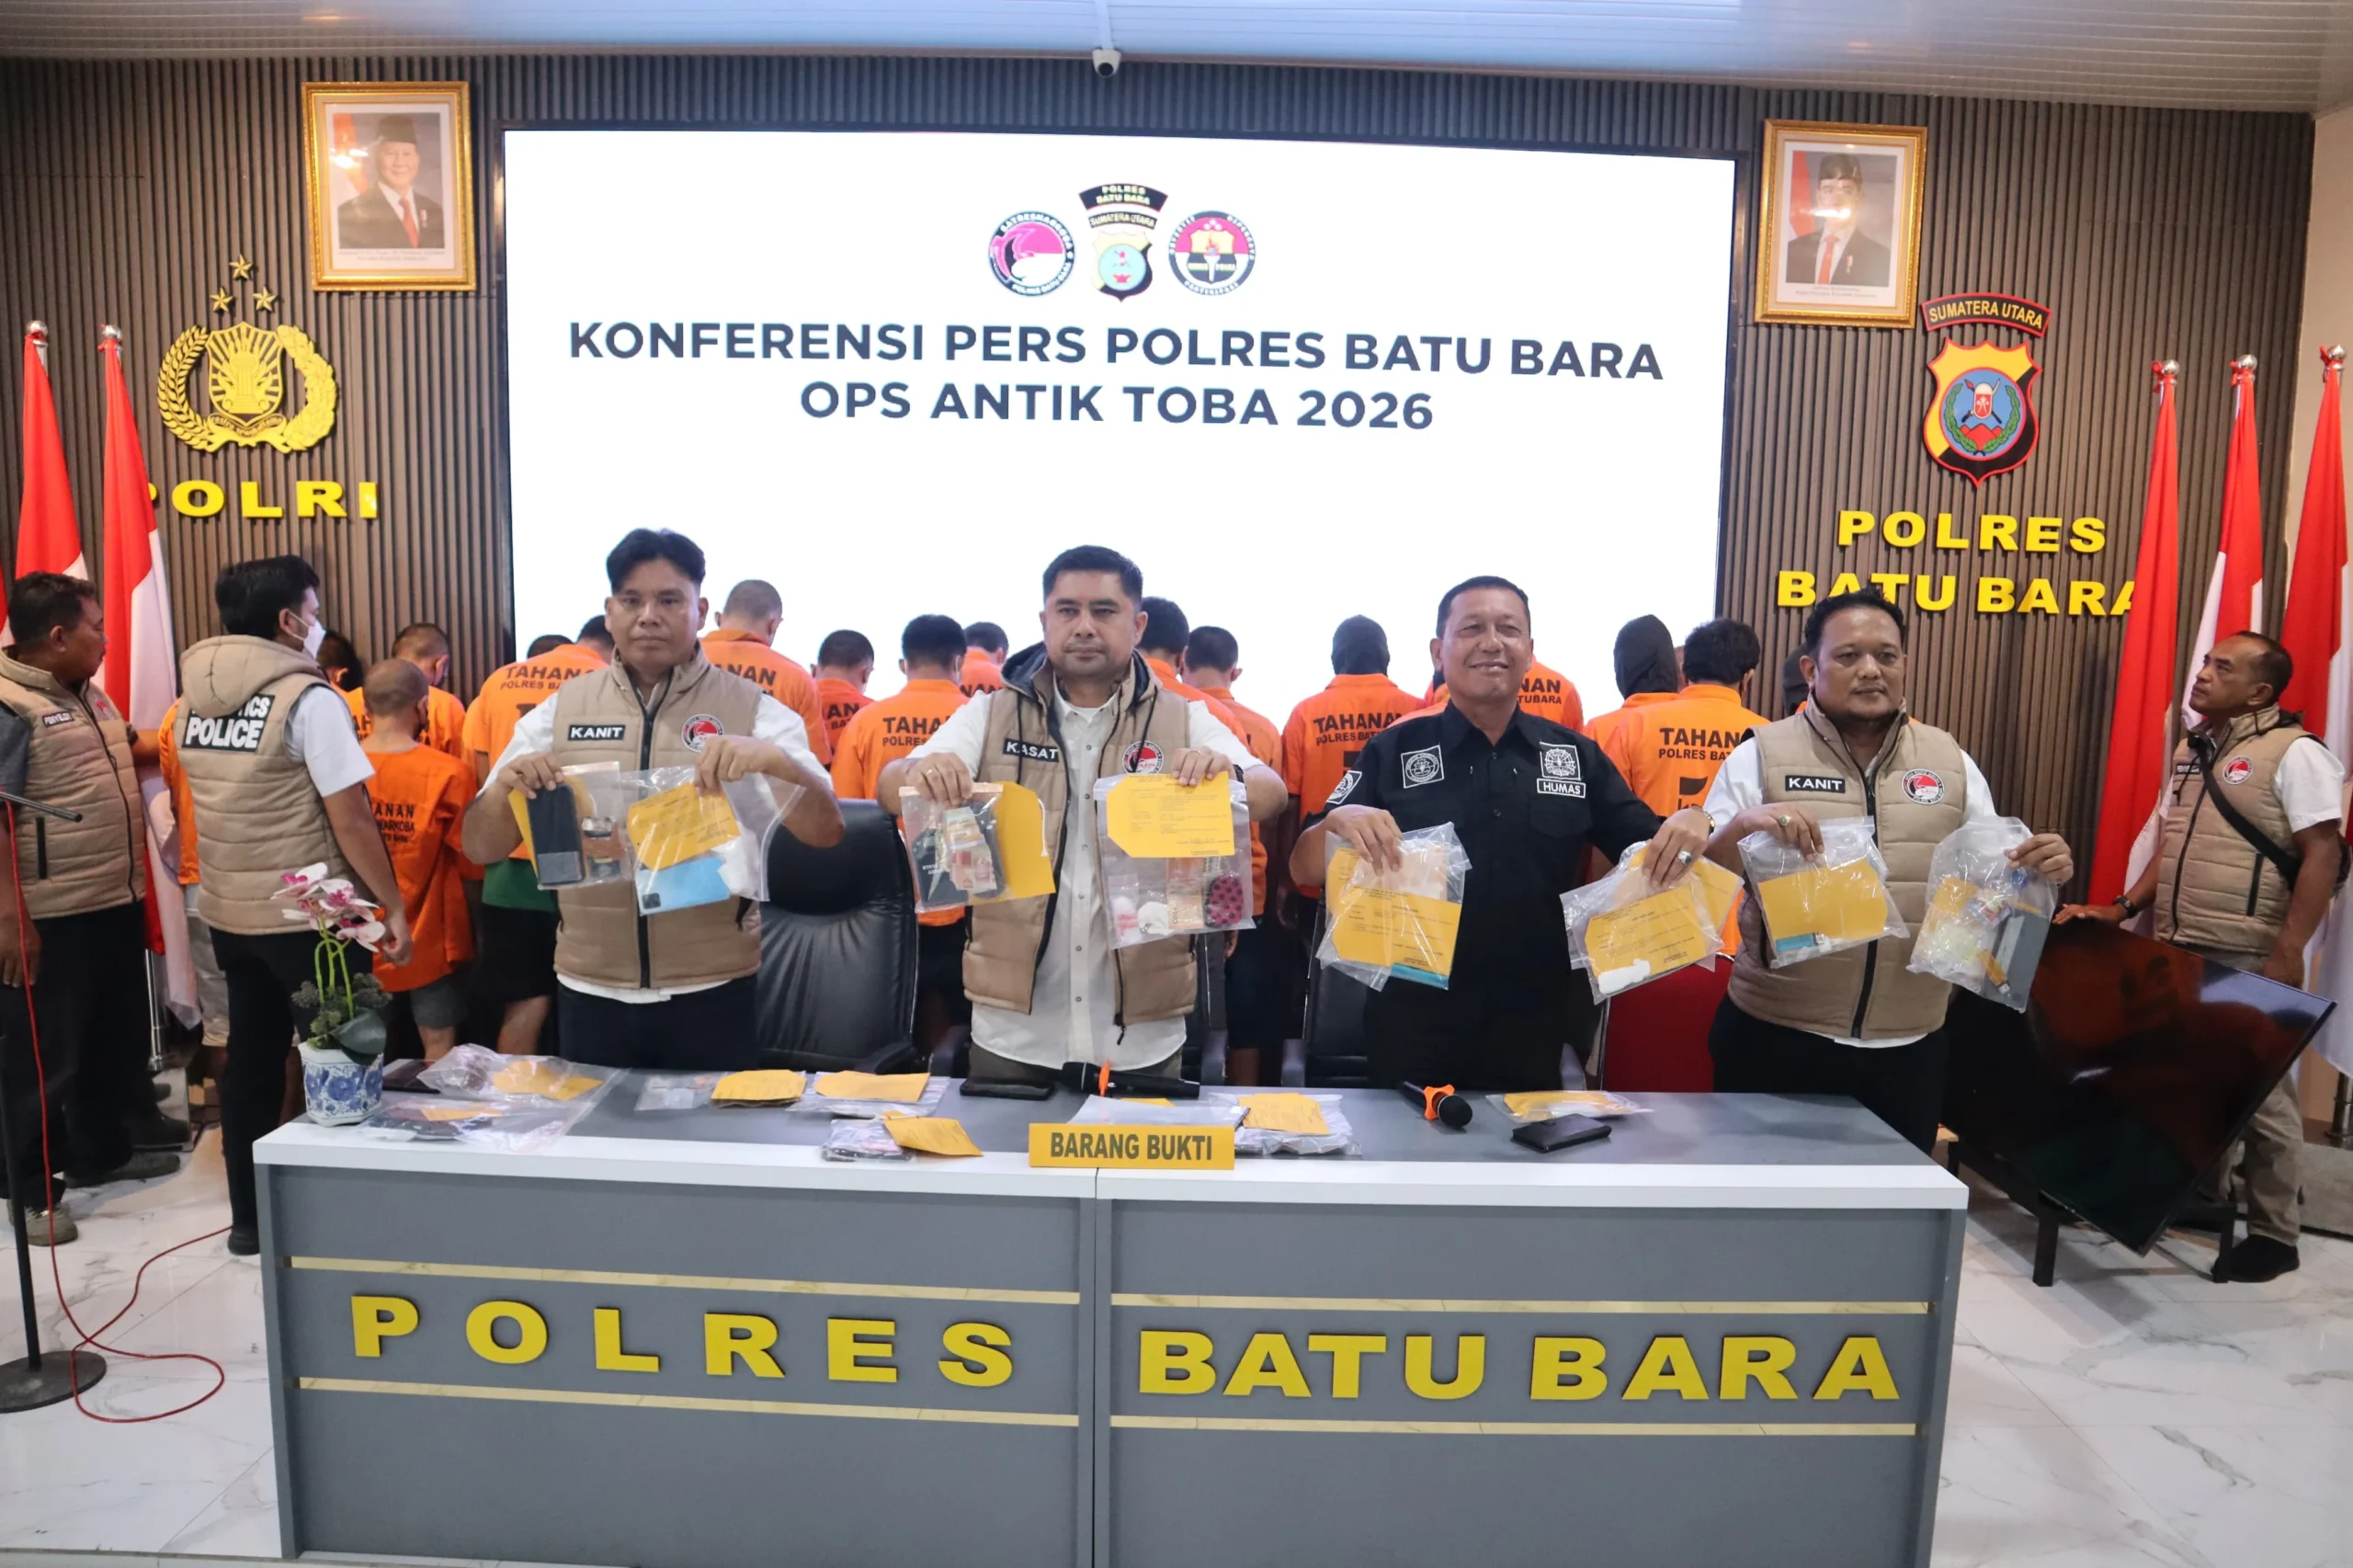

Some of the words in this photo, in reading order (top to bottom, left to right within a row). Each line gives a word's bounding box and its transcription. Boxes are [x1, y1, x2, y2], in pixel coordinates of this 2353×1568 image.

[1928, 301, 1999, 323] SUMATERA
[2002, 302, 2042, 329] UTARA
[570, 322, 923, 361] KONFERENSI
[946, 325, 1086, 363] PERS
[1108, 328, 1326, 369] POLRES
[1346, 334, 1492, 374] BATU
[1511, 339, 1663, 380] BARA
[801, 381, 911, 418] OPS
[931, 383, 1104, 422] ANTIK
[1122, 386, 1279, 426] TOBA
[1297, 391, 1433, 429] 2026
[148, 479, 378, 519] OLRI
[1838, 509, 2106, 553] POLRES
[500, 680, 544, 690] POLRES
[1518, 695, 1562, 704] TUBARA
[185, 716, 265, 749] POLICE
[570, 726, 624, 739] KANIT
[1313, 712, 1402, 733] TAHANA
[1316, 733, 1357, 746] POLRES
[1659, 728, 1741, 748] TAHAN
[1006, 741, 1059, 759] KASAT
[1658, 748, 1707, 761] POLRES
[1543, 781, 1581, 795] HUMAS
[1789, 778, 1843, 790] KANIT
[1050, 1131, 1140, 1160] BARANG
[1146, 1134, 1212, 1161] BUKTI
[351, 1295, 1014, 1388] POLRES
[1139, 1330, 1486, 1399] BATU
[1530, 1336, 1900, 1401] BARA
